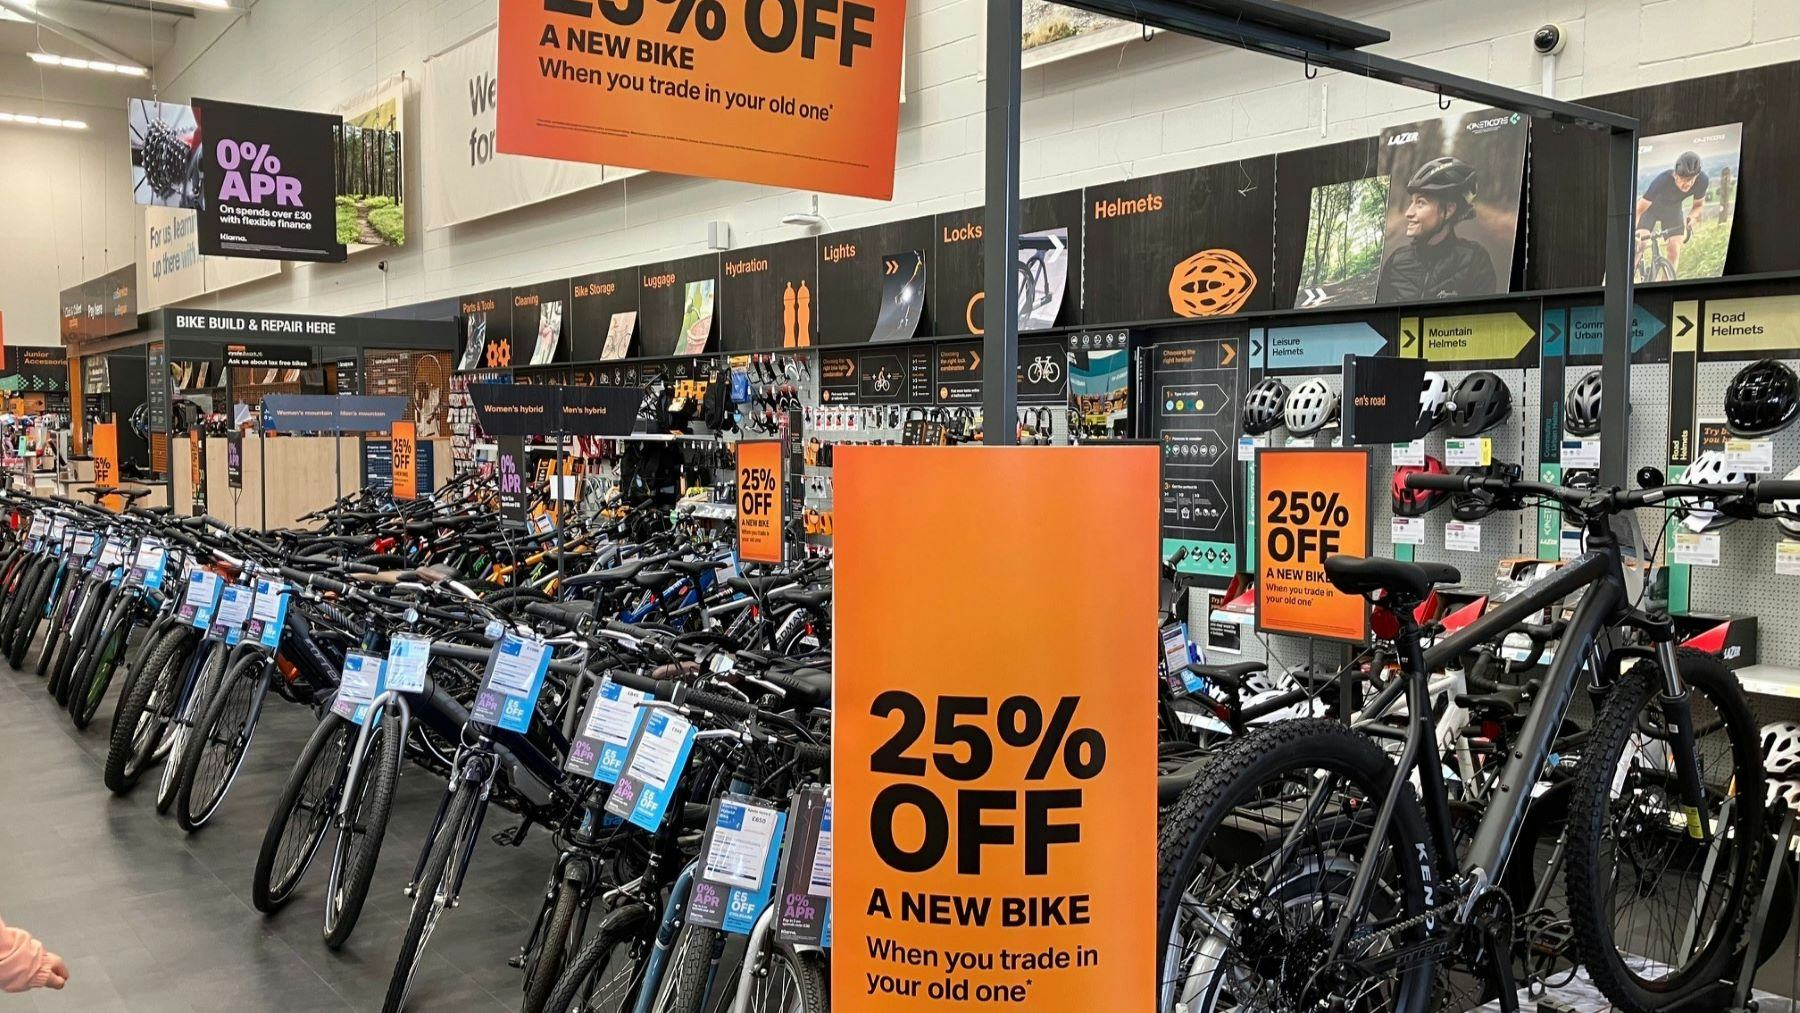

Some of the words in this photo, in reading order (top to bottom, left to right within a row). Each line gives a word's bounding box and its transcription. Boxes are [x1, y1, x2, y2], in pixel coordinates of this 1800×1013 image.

[744, 0, 875, 67] OFF
[539, 25, 560, 48] A
[567, 28, 630, 60] NEW
[636, 40, 695, 70] BIKE
[539, 57, 601, 85] When
[606, 68, 644, 93] you
[649, 75, 700, 100] trade
[705, 83, 720, 103] in
[726, 88, 765, 112] your
[770, 95, 795, 116] old
[1387, 132, 1419, 146] LAZER
[217, 139, 281, 174] 0%
[219, 171, 303, 207] APR
[220, 204, 234, 213] On
[236, 208, 270, 217] spends
[294, 211, 312, 220] £30
[1095, 193, 1163, 220] Helmets
[242, 216, 276, 227] flexible
[278, 219, 312, 230] finance
[150, 226, 161, 249] For
[943, 223, 983, 243] Locks
[824, 243, 856, 263] Lights
[162, 252, 180, 275] there
[725, 258, 768, 277] Hydration
[643, 273, 675, 288] Luggage
[575, 285, 588, 298] Bike
[590, 282, 615, 296] Storage
[463, 303, 477, 313] Parts
[482, 300, 495, 311] Tools
[514, 295, 539, 307] Cleaning
[176, 315, 205, 328] BIKE
[209, 317, 245, 330] BUILD
[249, 319, 258, 331] &
[262, 320, 303, 333] REPAIR
[306, 322, 336, 334] HERE
[1712, 312, 1745, 323] Road
[1429, 327, 1472, 337] Mountain
[1575, 331, 1603, 340] Urban
[1711, 324, 1764, 336] Helmets
[1272, 337, 1301, 346] Leisure
[1429, 339, 1467, 348] Helmets
[1272, 347, 1304, 356] Helmets
[1370, 394, 1386, 406] road
[484, 404, 519, 413] Women's
[520, 404, 544, 415] hybrid
[562, 405, 585, 415] Men's
[586, 405, 607, 416] hybrid
[1705, 427, 1720, 436] Try
[394, 438, 411, 454] 25%
[1680, 430, 1688, 460] Helmets
[1704, 438, 1719, 446] you
[1672, 440, 1680, 460] Road
[95, 457, 111, 469] 5%
[394, 454, 410, 470] OFF
[501, 455, 515, 473] 0%
[502, 474, 521, 493] APR
[742, 468, 775, 491] 25%
[742, 492, 772, 515] OFF
[1267, 490, 1348, 528] 25%
[1267, 527, 1340, 564] OFF
[1267, 568, 1274, 578] A
[1277, 568, 1303, 580] NEW
[1266, 583, 1287, 592] When
[1304, 587, 1324, 596] trade
[1266, 595, 1283, 604] your
[1285, 597, 1296, 605] old
[478, 699, 498, 710] APR
[506, 707, 524, 718] OFF
[870, 690, 1106, 781] 25%
[573, 749, 594, 761] APR
[602, 757, 621, 768] OFF
[615, 788, 634, 801] APR
[640, 798, 659, 811] OFF
[870, 783, 1082, 875] OFF
[696, 883, 715, 896] 0%
[733, 890, 747, 901] £5
[694, 893, 720, 907] APR
[786, 893, 809, 907] 0%
[731, 901, 755, 914] OFF
[784, 906, 815, 919] APR
[867, 888, 892, 918] A
[902, 891, 991, 927] NEW
[1001, 894, 1090, 927] BIKE
[866, 936, 938, 967] When
[945, 951, 993, 973] you
[1000, 947, 1070, 969] trade
[1076, 945, 1098, 967] in
[866, 972, 921, 996] your
[928, 978, 968, 1000] old
